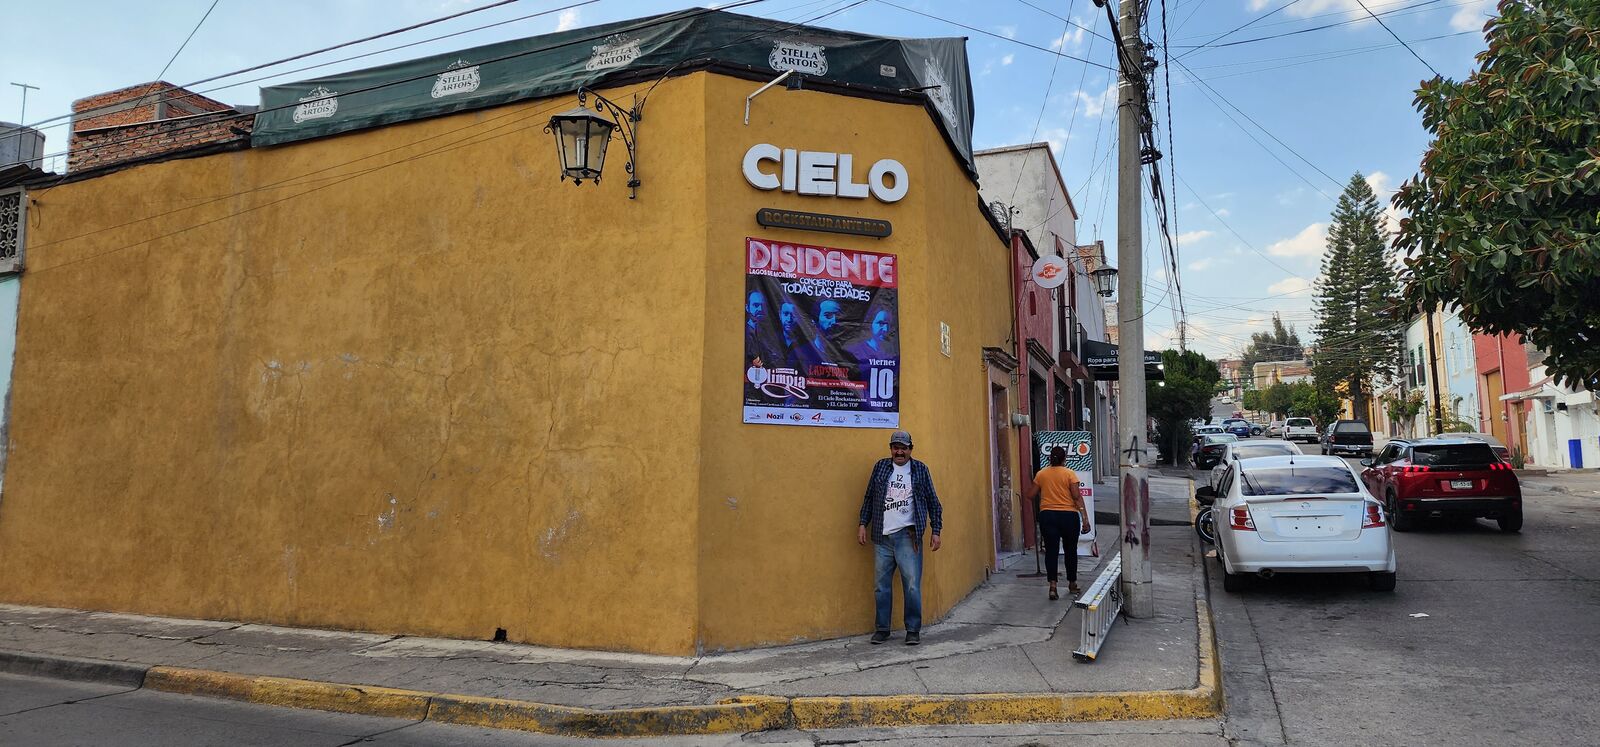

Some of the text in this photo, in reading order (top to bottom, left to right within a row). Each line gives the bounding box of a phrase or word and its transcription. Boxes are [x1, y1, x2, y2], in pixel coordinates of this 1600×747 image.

[782, 47, 818, 59] STELLA
[597, 54, 632, 65] ARTOIS
[780, 57, 818, 68] ARTOIS
[442, 73, 473, 84] STELLA
[441, 81, 472, 91] ARTOIS
[303, 99, 331, 109] STELLA
[302, 106, 330, 115] ARTOIS
[742, 143, 909, 203] CIELO
[764, 211, 886, 233] ROCKSTAURANTE BAR
[750, 240, 893, 283] DISIDENTE
[749, 268, 767, 276] LAGOS
[772, 271, 797, 279] MORENO
[799, 277, 853, 289] CONCIERTO PARA
[782, 282, 871, 302] TODAS LAS EDADES
[869, 358, 896, 367] Viernes
[870, 367, 894, 400] 10
[870, 400, 893, 408] marzo
